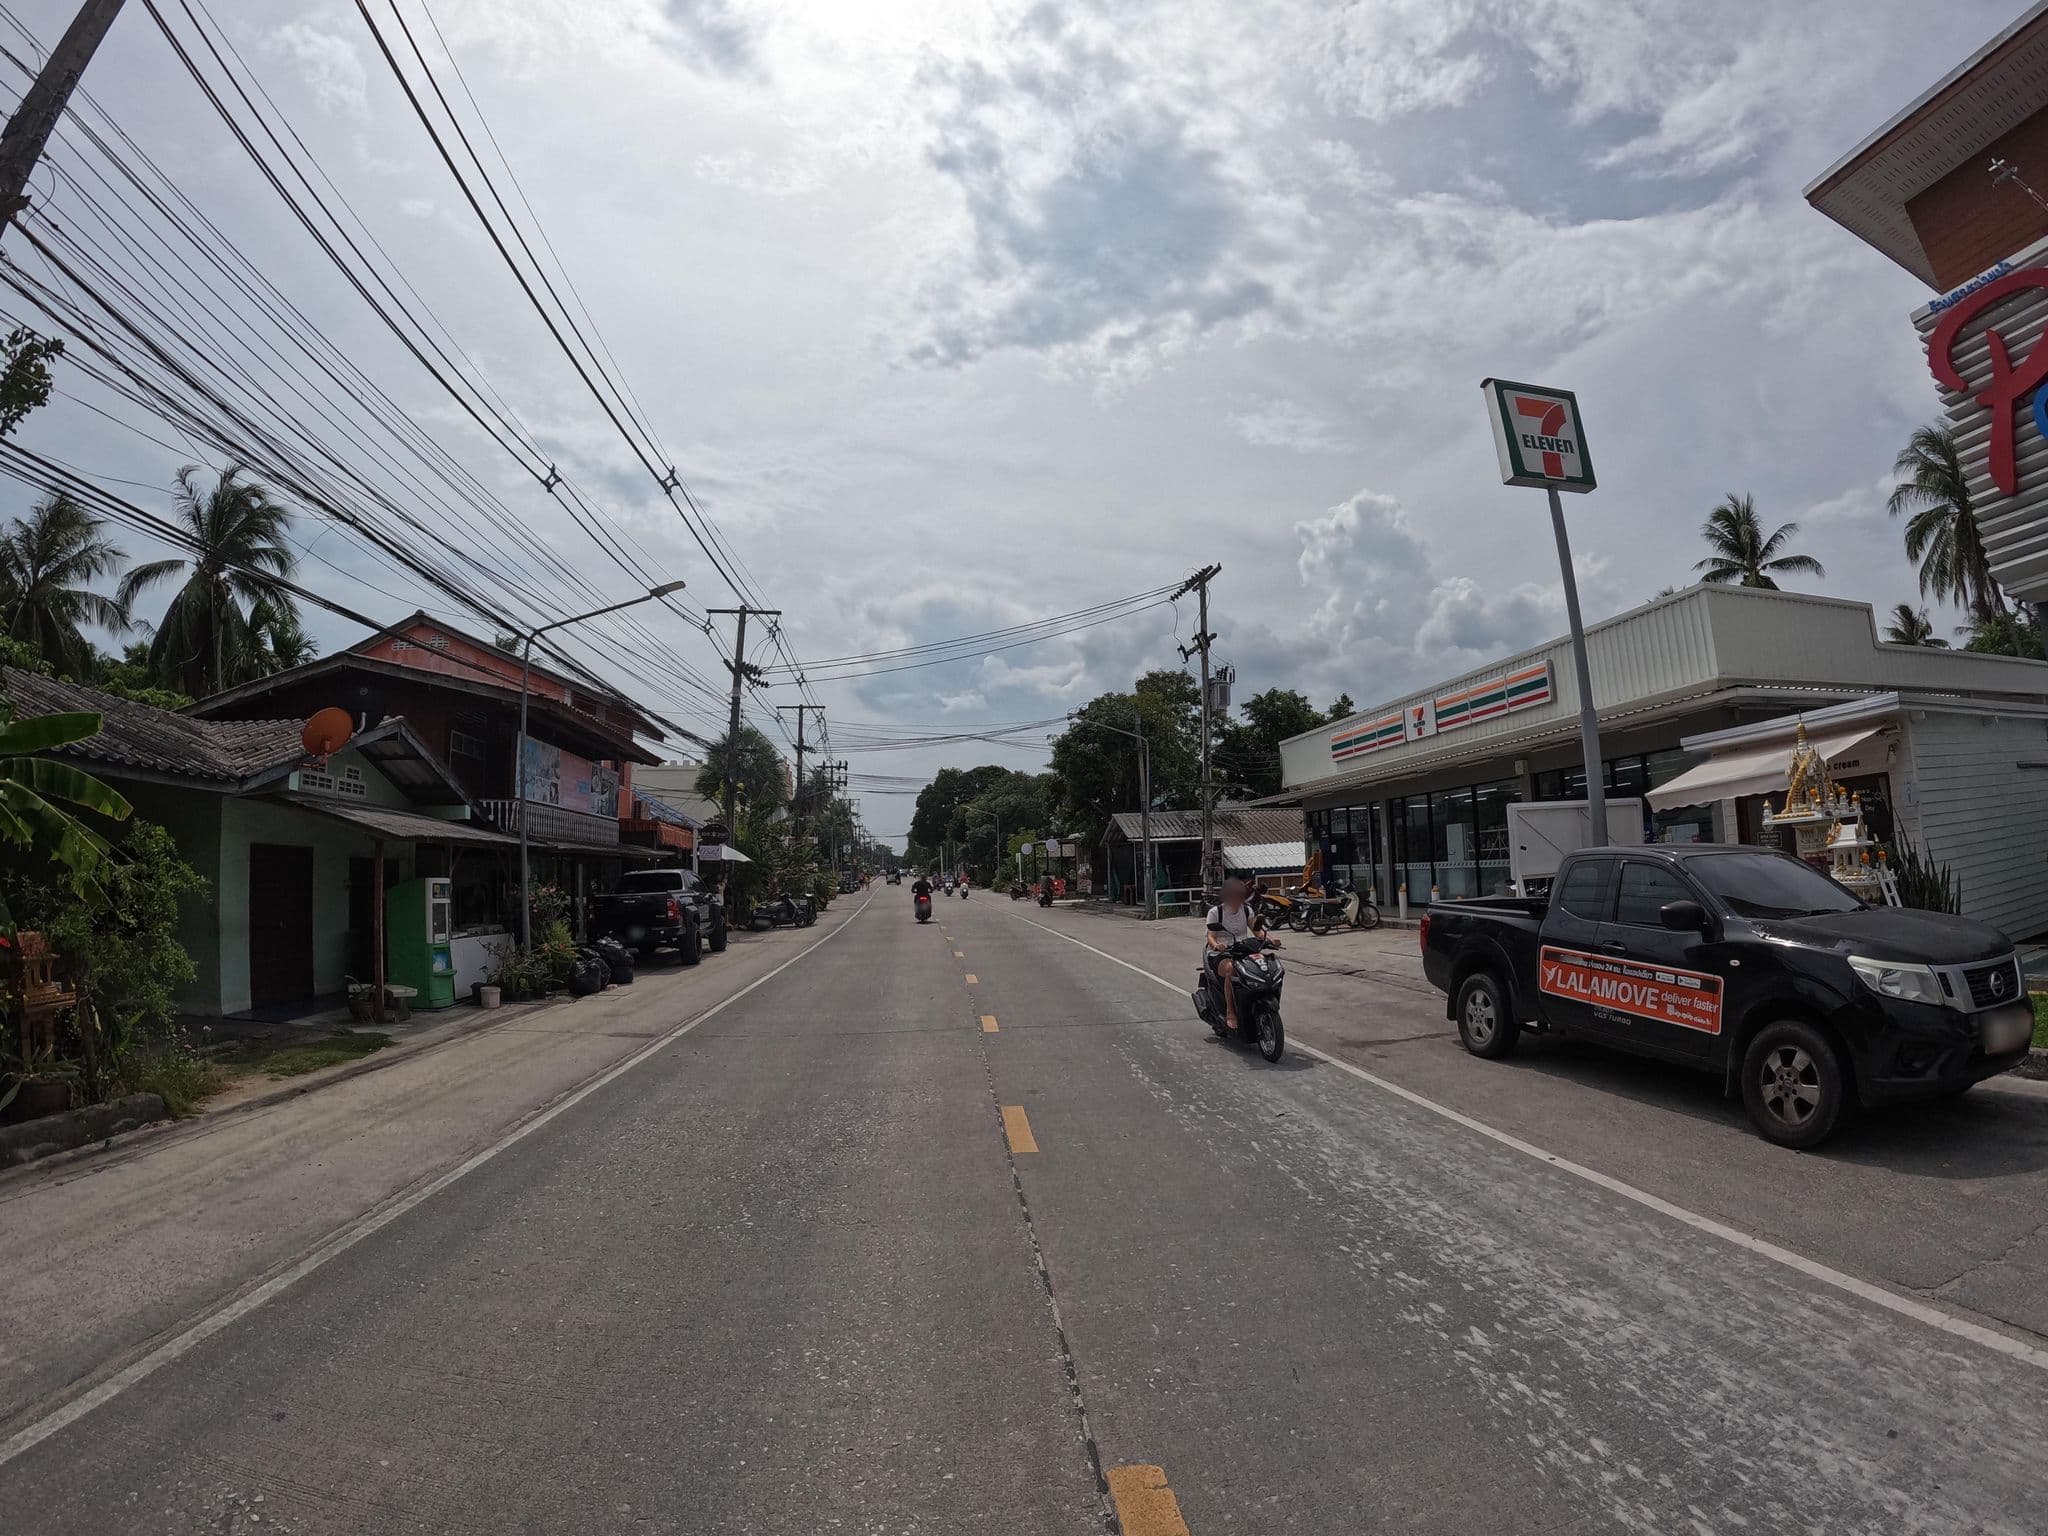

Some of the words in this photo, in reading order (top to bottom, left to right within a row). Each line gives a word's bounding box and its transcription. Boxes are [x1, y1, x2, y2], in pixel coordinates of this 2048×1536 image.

[1513, 396, 1567, 479] 7
[1833, 759, 1860, 770] cream
[1605, 964, 1613, 973] 24
[1556, 968, 1660, 1010] LALAMOVE
[1661, 991, 1692, 1006] deliver
[1693, 997, 1719, 1013] faster
